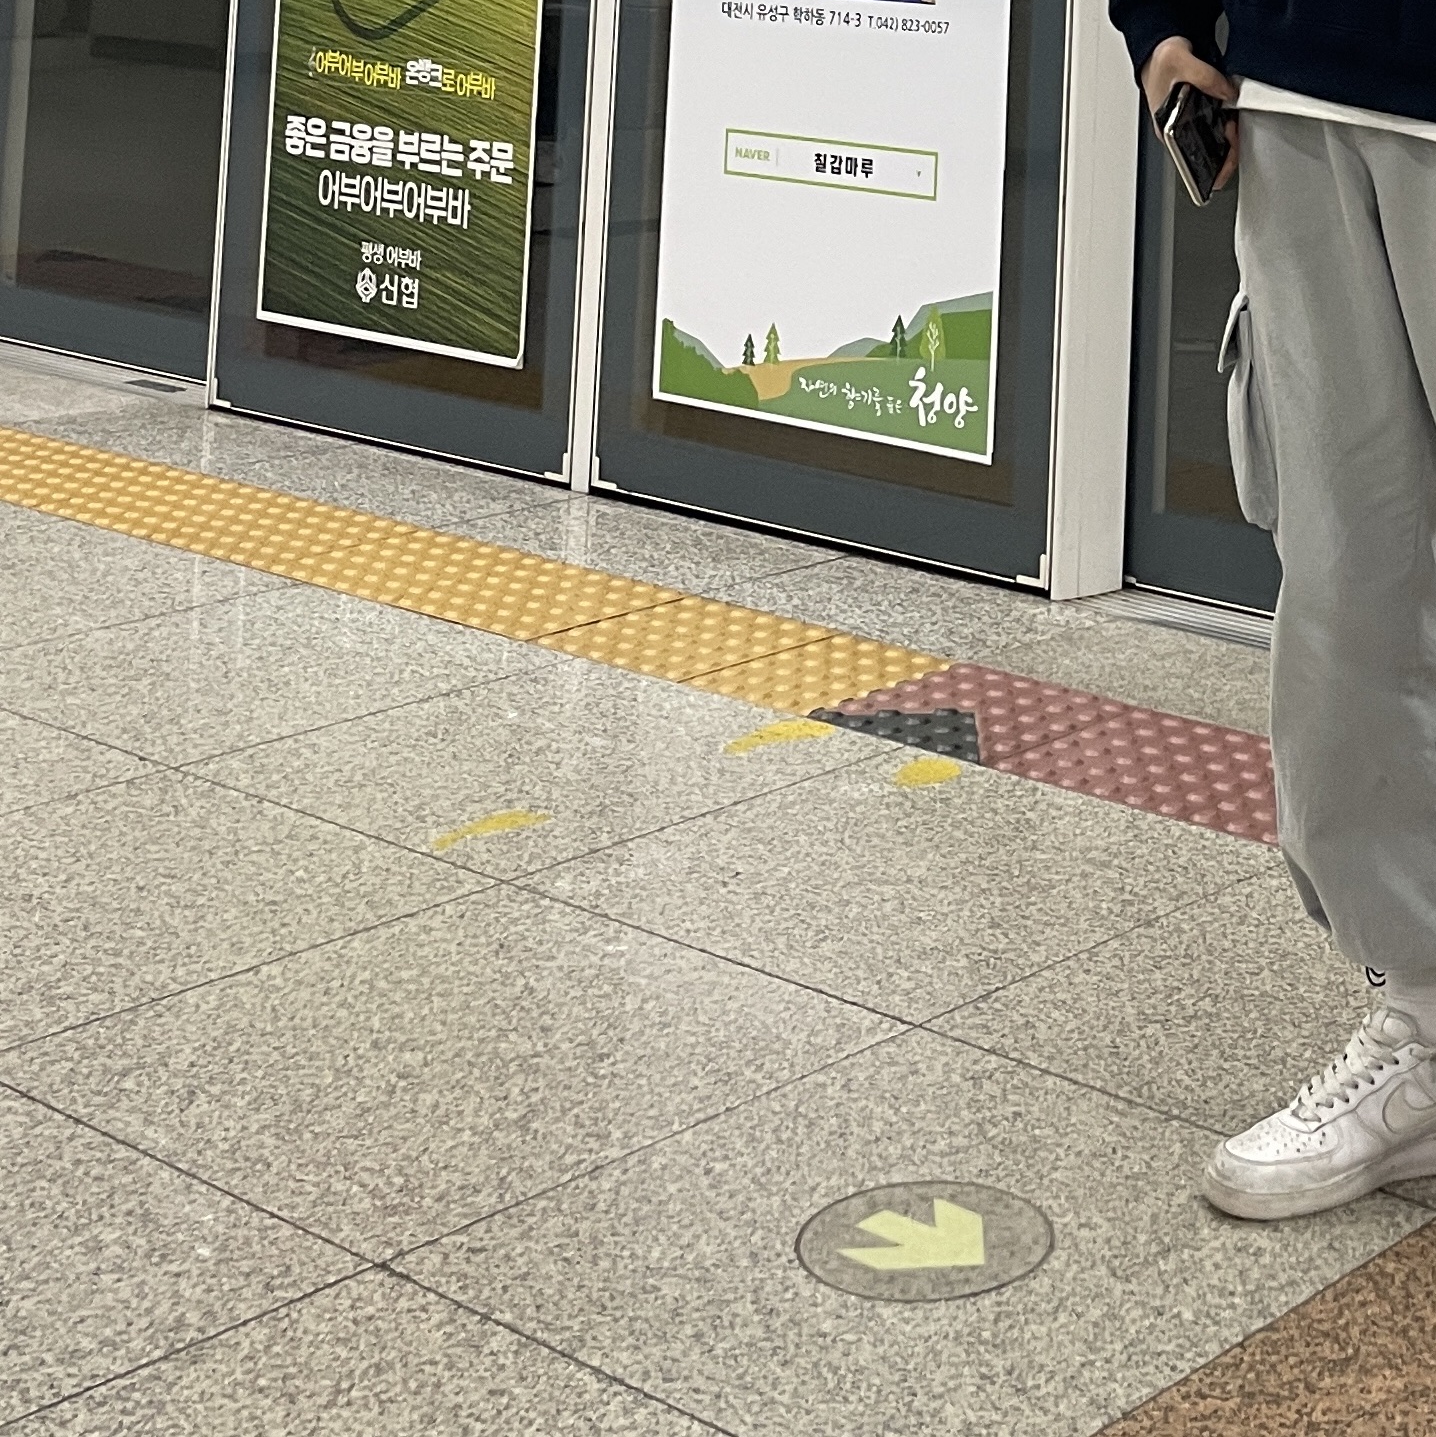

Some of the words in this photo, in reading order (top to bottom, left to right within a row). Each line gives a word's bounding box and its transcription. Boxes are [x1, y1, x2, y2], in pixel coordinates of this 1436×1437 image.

[721, 1, 754, 20] 대전시
[756, 4, 790, 23] 유성구
[793, 7, 826, 26] 학하동
[829, 10, 862, 28] 714-3
[901, 17, 950, 35] 823-0057
[285, 114, 327, 159] 좋은
[330, 120, 394, 167] 금융을
[397, 130, 464, 177] 부르는
[467, 139, 514, 184] 주문
[735, 146, 770, 162] NAVER
[814, 152, 874, 178] 칠갑마루
[318, 169, 471, 229] 어부어부어부바
[361, 241, 384, 264] 평생
[386, 246, 422, 270] 어부바
[379, 273, 420, 309] 신협
[908, 366, 979, 429] 청양
